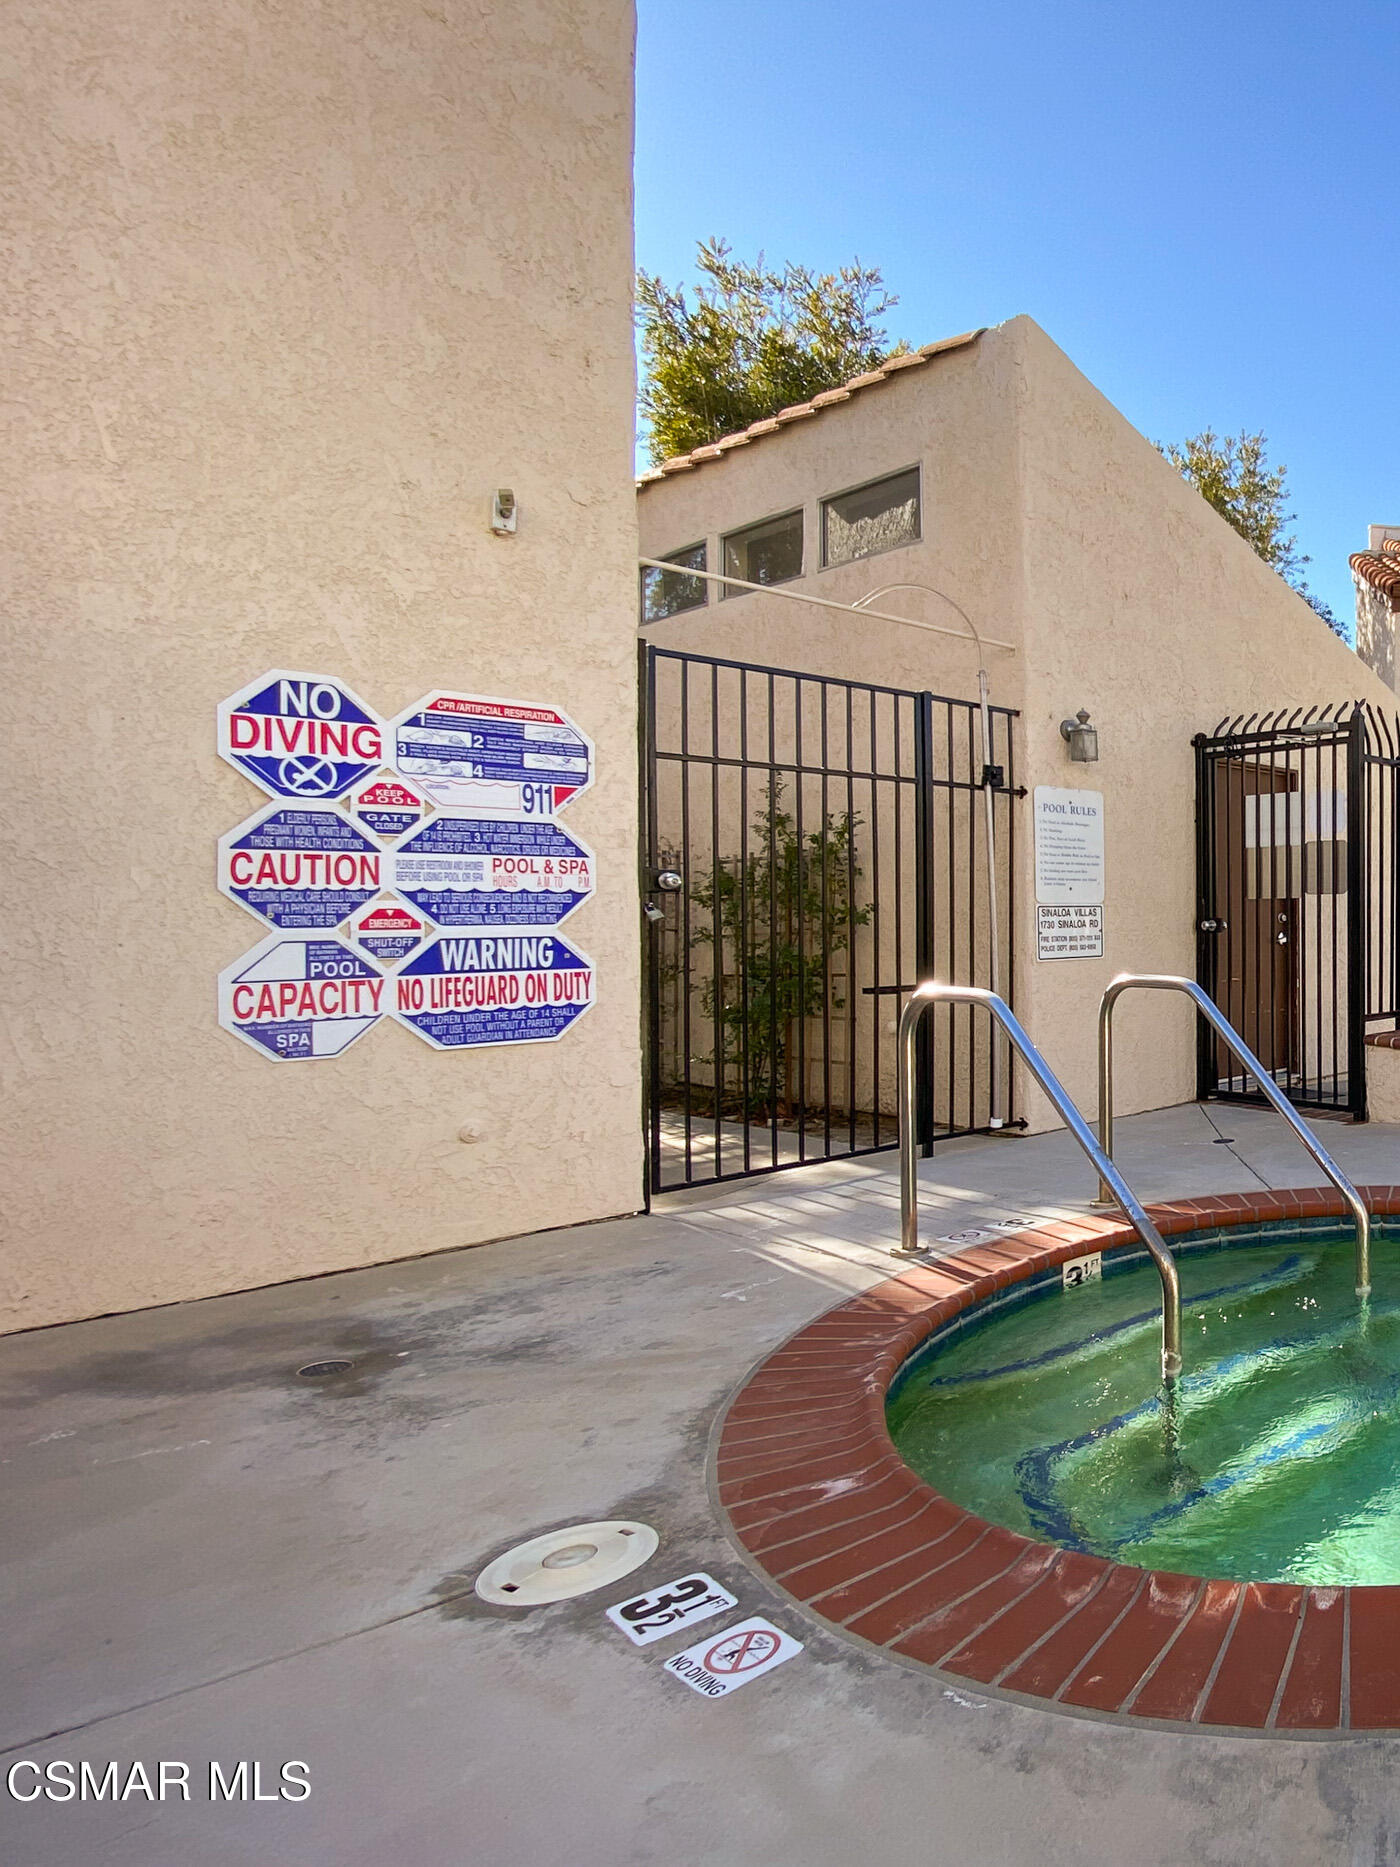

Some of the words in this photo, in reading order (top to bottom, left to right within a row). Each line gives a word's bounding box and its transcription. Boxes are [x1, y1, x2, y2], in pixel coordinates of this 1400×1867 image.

[280, 680, 341, 719] NO
[437, 700, 457, 710] CPR
[503, 708, 555, 721] RESPIRATION
[418, 714, 425, 726] 1
[230, 714, 382, 759] DIVING
[473, 735, 484, 749] 2
[398, 743, 407, 756] 3
[473, 764, 484, 778] 4
[375, 789, 404, 797] KEEP
[522, 783, 553, 815] 911
[363, 795, 417, 805] POOL
[1043, 803, 1067, 814] POOL
[1070, 805, 1097, 816] RULES
[279, 813, 285, 824] 1
[366, 813, 413, 822] GATE
[374, 822, 404, 830] CLOSED
[436, 820, 444, 830] 2
[250, 835, 275, 847] THOSE
[276, 836, 294, 847] WITH
[295, 837, 321, 848] HEALTH
[322, 838, 364, 849] CONDITIONS
[474, 832, 481, 842] 3
[230, 851, 380, 886] CAUTION
[396, 860, 414, 870] PLEASE
[492, 858, 539, 874] POOL
[544, 858, 554, 874] &
[558, 859, 589, 875] SPA
[396, 871, 422, 882] BEFORE
[423, 872, 443, 882] USING
[444, 872, 460, 882] POOL
[462, 872, 472, 882] OR
[472, 872, 484, 882] SPA
[493, 875, 518, 888] HOURS
[554, 876, 563, 888] TO
[267, 903, 284, 914] WITH
[285, 903, 290, 914] A
[290, 903, 325, 914] PHYSICIAN
[326, 902, 351, 914] BEFORE
[431, 904, 438, 914] 4
[489, 903, 496, 914] 5
[1041, 908, 1071, 917] SINALOA
[1074, 908, 1097, 917] VILLAS
[281, 914, 312, 926] ENTERING
[313, 915, 325, 926] THE
[326, 915, 337, 926] SPA
[368, 918, 413, 929] EMERGENCY
[1040, 920, 1055, 929] 1730
[1057, 919, 1086, 928] SINALOA
[1089, 919, 1099, 928] RD
[368, 938, 414, 948] SHUT-OFF
[376, 947, 404, 957] SWITCH
[439, 938, 554, 972] WARNING
[310, 961, 366, 977] POOL
[397, 978, 424, 1011] NO
[431, 975, 519, 1009] LIFEGUARD
[524, 973, 548, 1003] ON
[554, 971, 592, 1001] DUTY
[233, 979, 385, 1020] CAPACITY
[417, 1014, 461, 1026] CHILDREN
[463, 1013, 492, 1024] UNDER
[493, 1011, 509, 1021] THE
[510, 1010, 527, 1020] AGE
[528, 1009, 539, 1019] OF
[541, 1009, 550, 1018] 14
[551, 1007, 576, 1018] SHALL
[431, 1024, 447, 1035] NOT
[449, 1023, 464, 1034] USE
[465, 1022, 485, 1033] POOL
[487, 1020, 520, 1031] WITHOUT
[520, 1019, 526, 1029] A
[527, 1018, 553, 1028] PARENT
[554, 1017, 564, 1026] OR
[276, 1033, 310, 1048] SPA
[442, 1034, 465, 1045] ADULT
[467, 1031, 503, 1043] GUARDIAN
[504, 1030, 513, 1040] IN
[514, 1027, 557, 1039] ATTENDANCE
[1091, 1258, 1100, 1268] FT
[709, 1597, 730, 1609] FT
[670, 1655, 694, 1672] NO
[684, 1666, 726, 1697] DIVING
